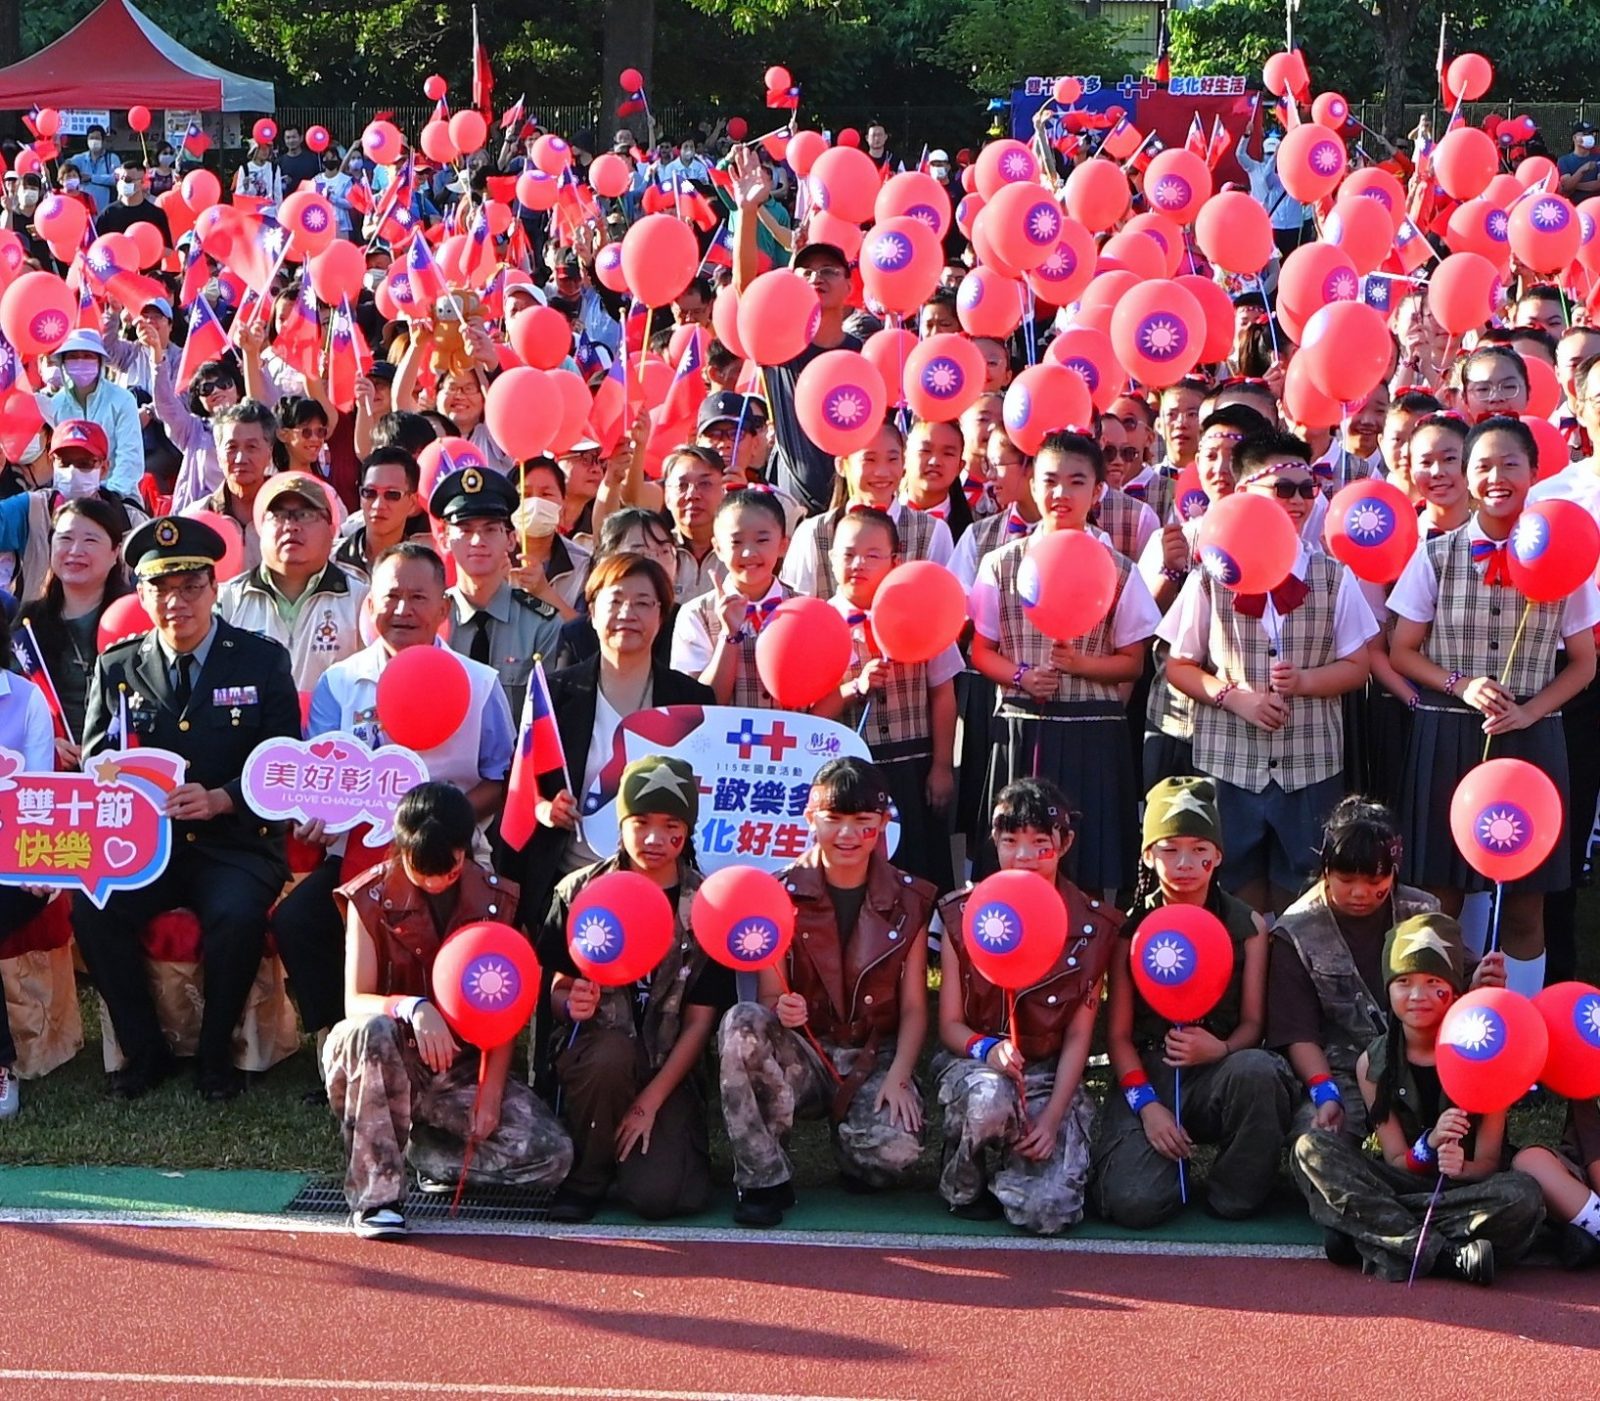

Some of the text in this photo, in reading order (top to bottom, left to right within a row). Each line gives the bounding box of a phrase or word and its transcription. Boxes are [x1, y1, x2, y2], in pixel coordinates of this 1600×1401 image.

[1025, 75, 1101, 96] 雙十多
[1168, 76, 1246, 95] 彰化好生活
[265, 762, 410, 796] 美好彰化
[16, 787, 134, 828] 雙十節
[288, 793, 319, 804] LOVE
[321, 796, 384, 808] CHANGHUA
[14, 829, 92, 869] 快樂
[701, 818, 810, 858] 化好生
